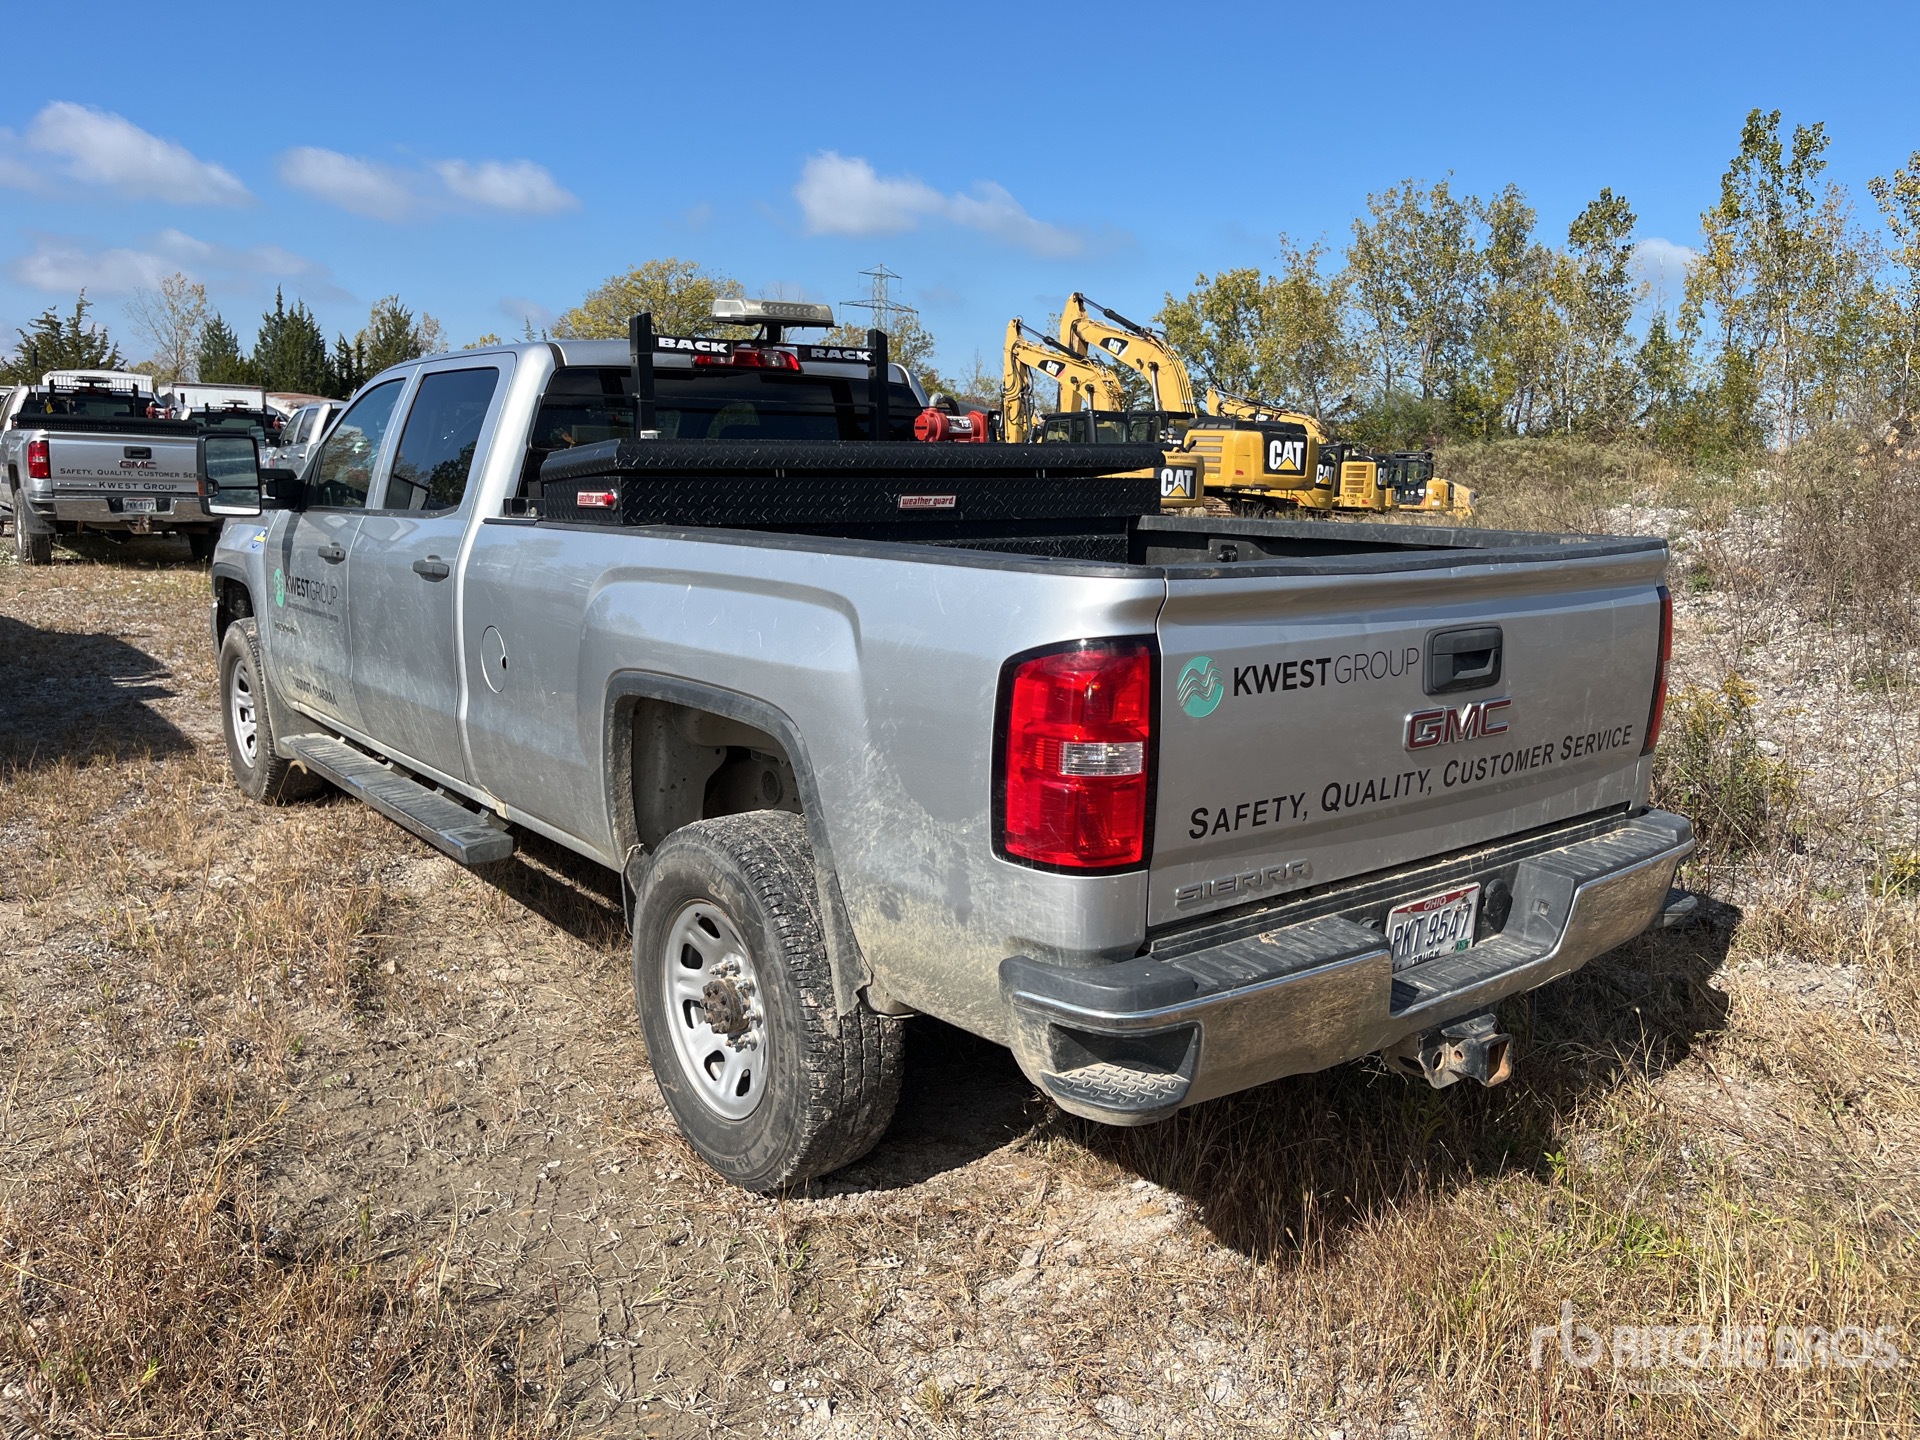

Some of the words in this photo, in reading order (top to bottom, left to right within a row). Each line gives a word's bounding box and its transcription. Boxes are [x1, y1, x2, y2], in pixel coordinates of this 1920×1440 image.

[657, 336, 728, 353] BACK
[811, 348, 871, 361] RACK
[1107, 338, 1122, 354] CAT
[1045, 360, 1060, 376] CAT
[119, 460, 157, 470] GMC
[1268, 439, 1304, 471] CAT
[60, 468, 93, 476] SAFETY,
[97, 469, 134, 478] QUALITY,
[137, 470, 180, 479] CUSTOMER
[1160, 468, 1194, 498] CAT
[1315, 463, 1335, 486] CAT
[99, 481, 138, 490] KWEST
[143, 482, 178, 491] GROUP
[902, 496, 933, 505] weather
[933, 496, 954, 507] guard
[1402, 695, 1513, 751] GMC
[1188, 792, 1308, 840] SAFETY,
[1321, 768, 1432, 813] QUALITY,
[1443, 743, 1555, 788] CUSTOMER
[1560, 724, 1633, 760] SERVICE
[1174, 858, 1312, 907] SIERRA
[1423, 896, 1447, 911] OHIO
[1391, 915, 1425, 958] PKT
[1425, 903, 1472, 947] 9547
